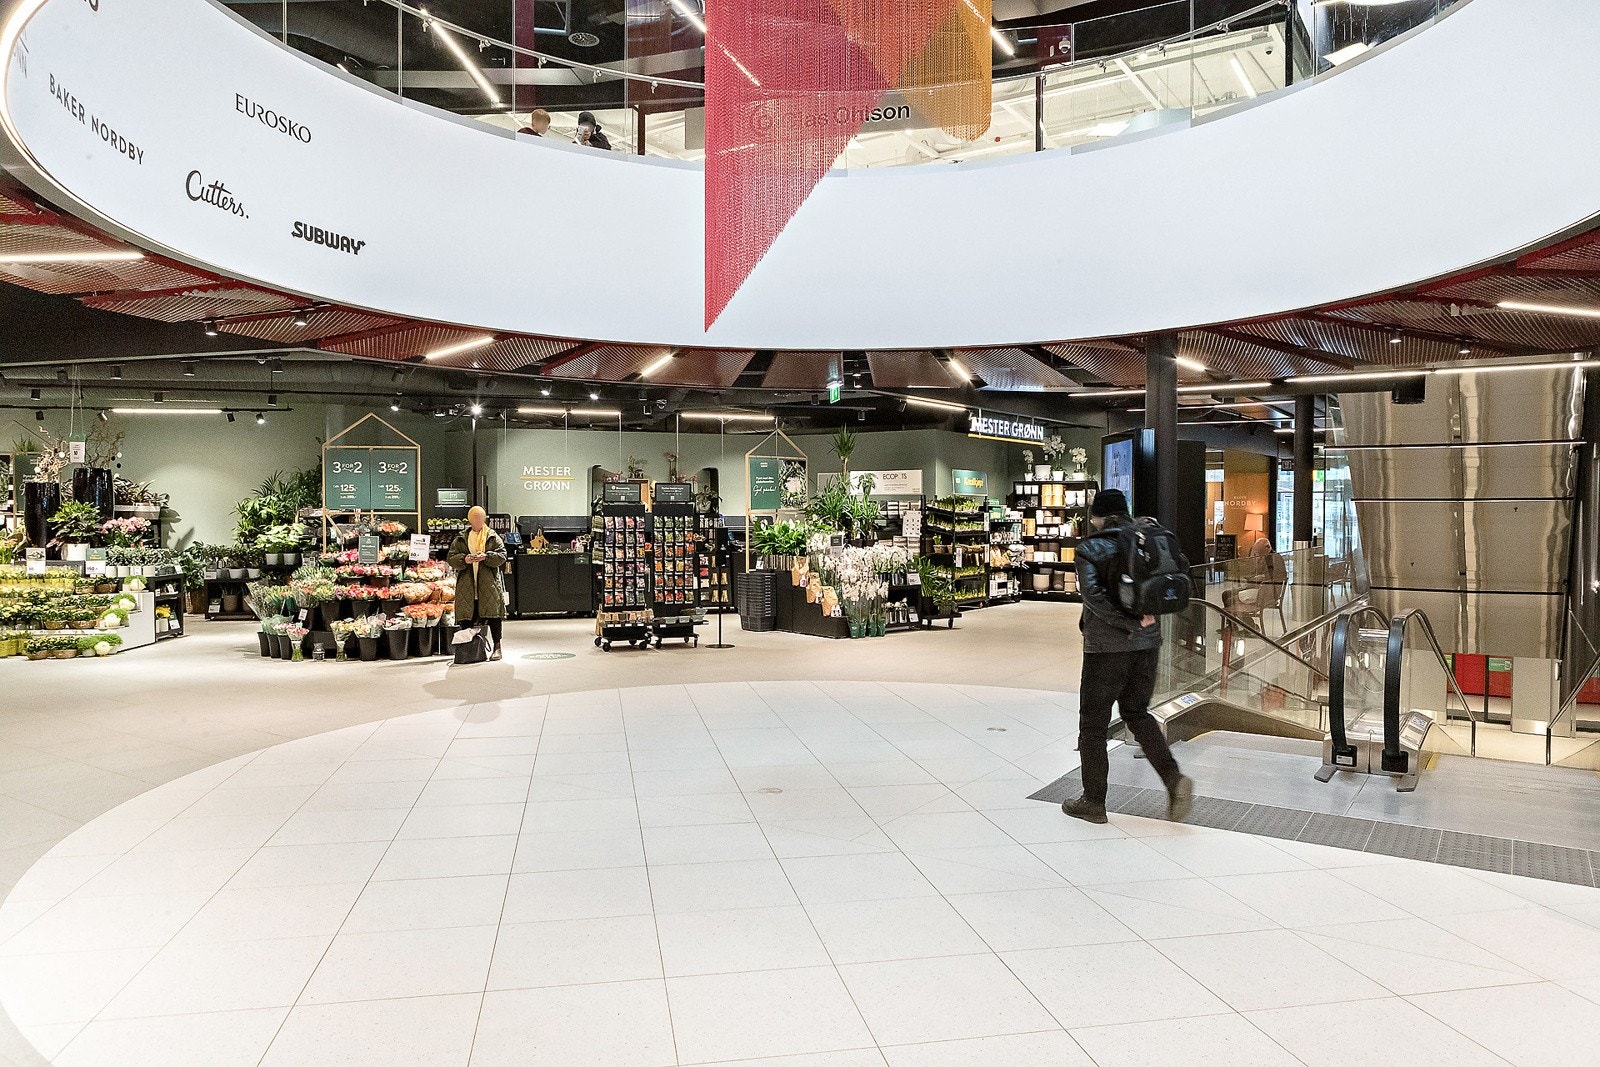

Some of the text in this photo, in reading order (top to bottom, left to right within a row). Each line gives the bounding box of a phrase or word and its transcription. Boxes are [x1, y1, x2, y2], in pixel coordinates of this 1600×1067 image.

[49, 73, 144, 165] BAKER NORDBY
[235, 92, 312, 144] EUROSKO
[834, 103, 911, 125] Ohlson
[291, 220, 366, 256] SUBWAY
[970, 416, 1044, 441] MESTER GRØNN
[332, 461, 342, 474] 3
[353, 461, 363, 474] 2
[378, 461, 388, 474] 3
[398, 461, 408, 474] 2
[523, 465, 572, 476] MESTER
[882, 472, 908, 480] ECOPTS
[523, 480, 570, 491] GRØNN
